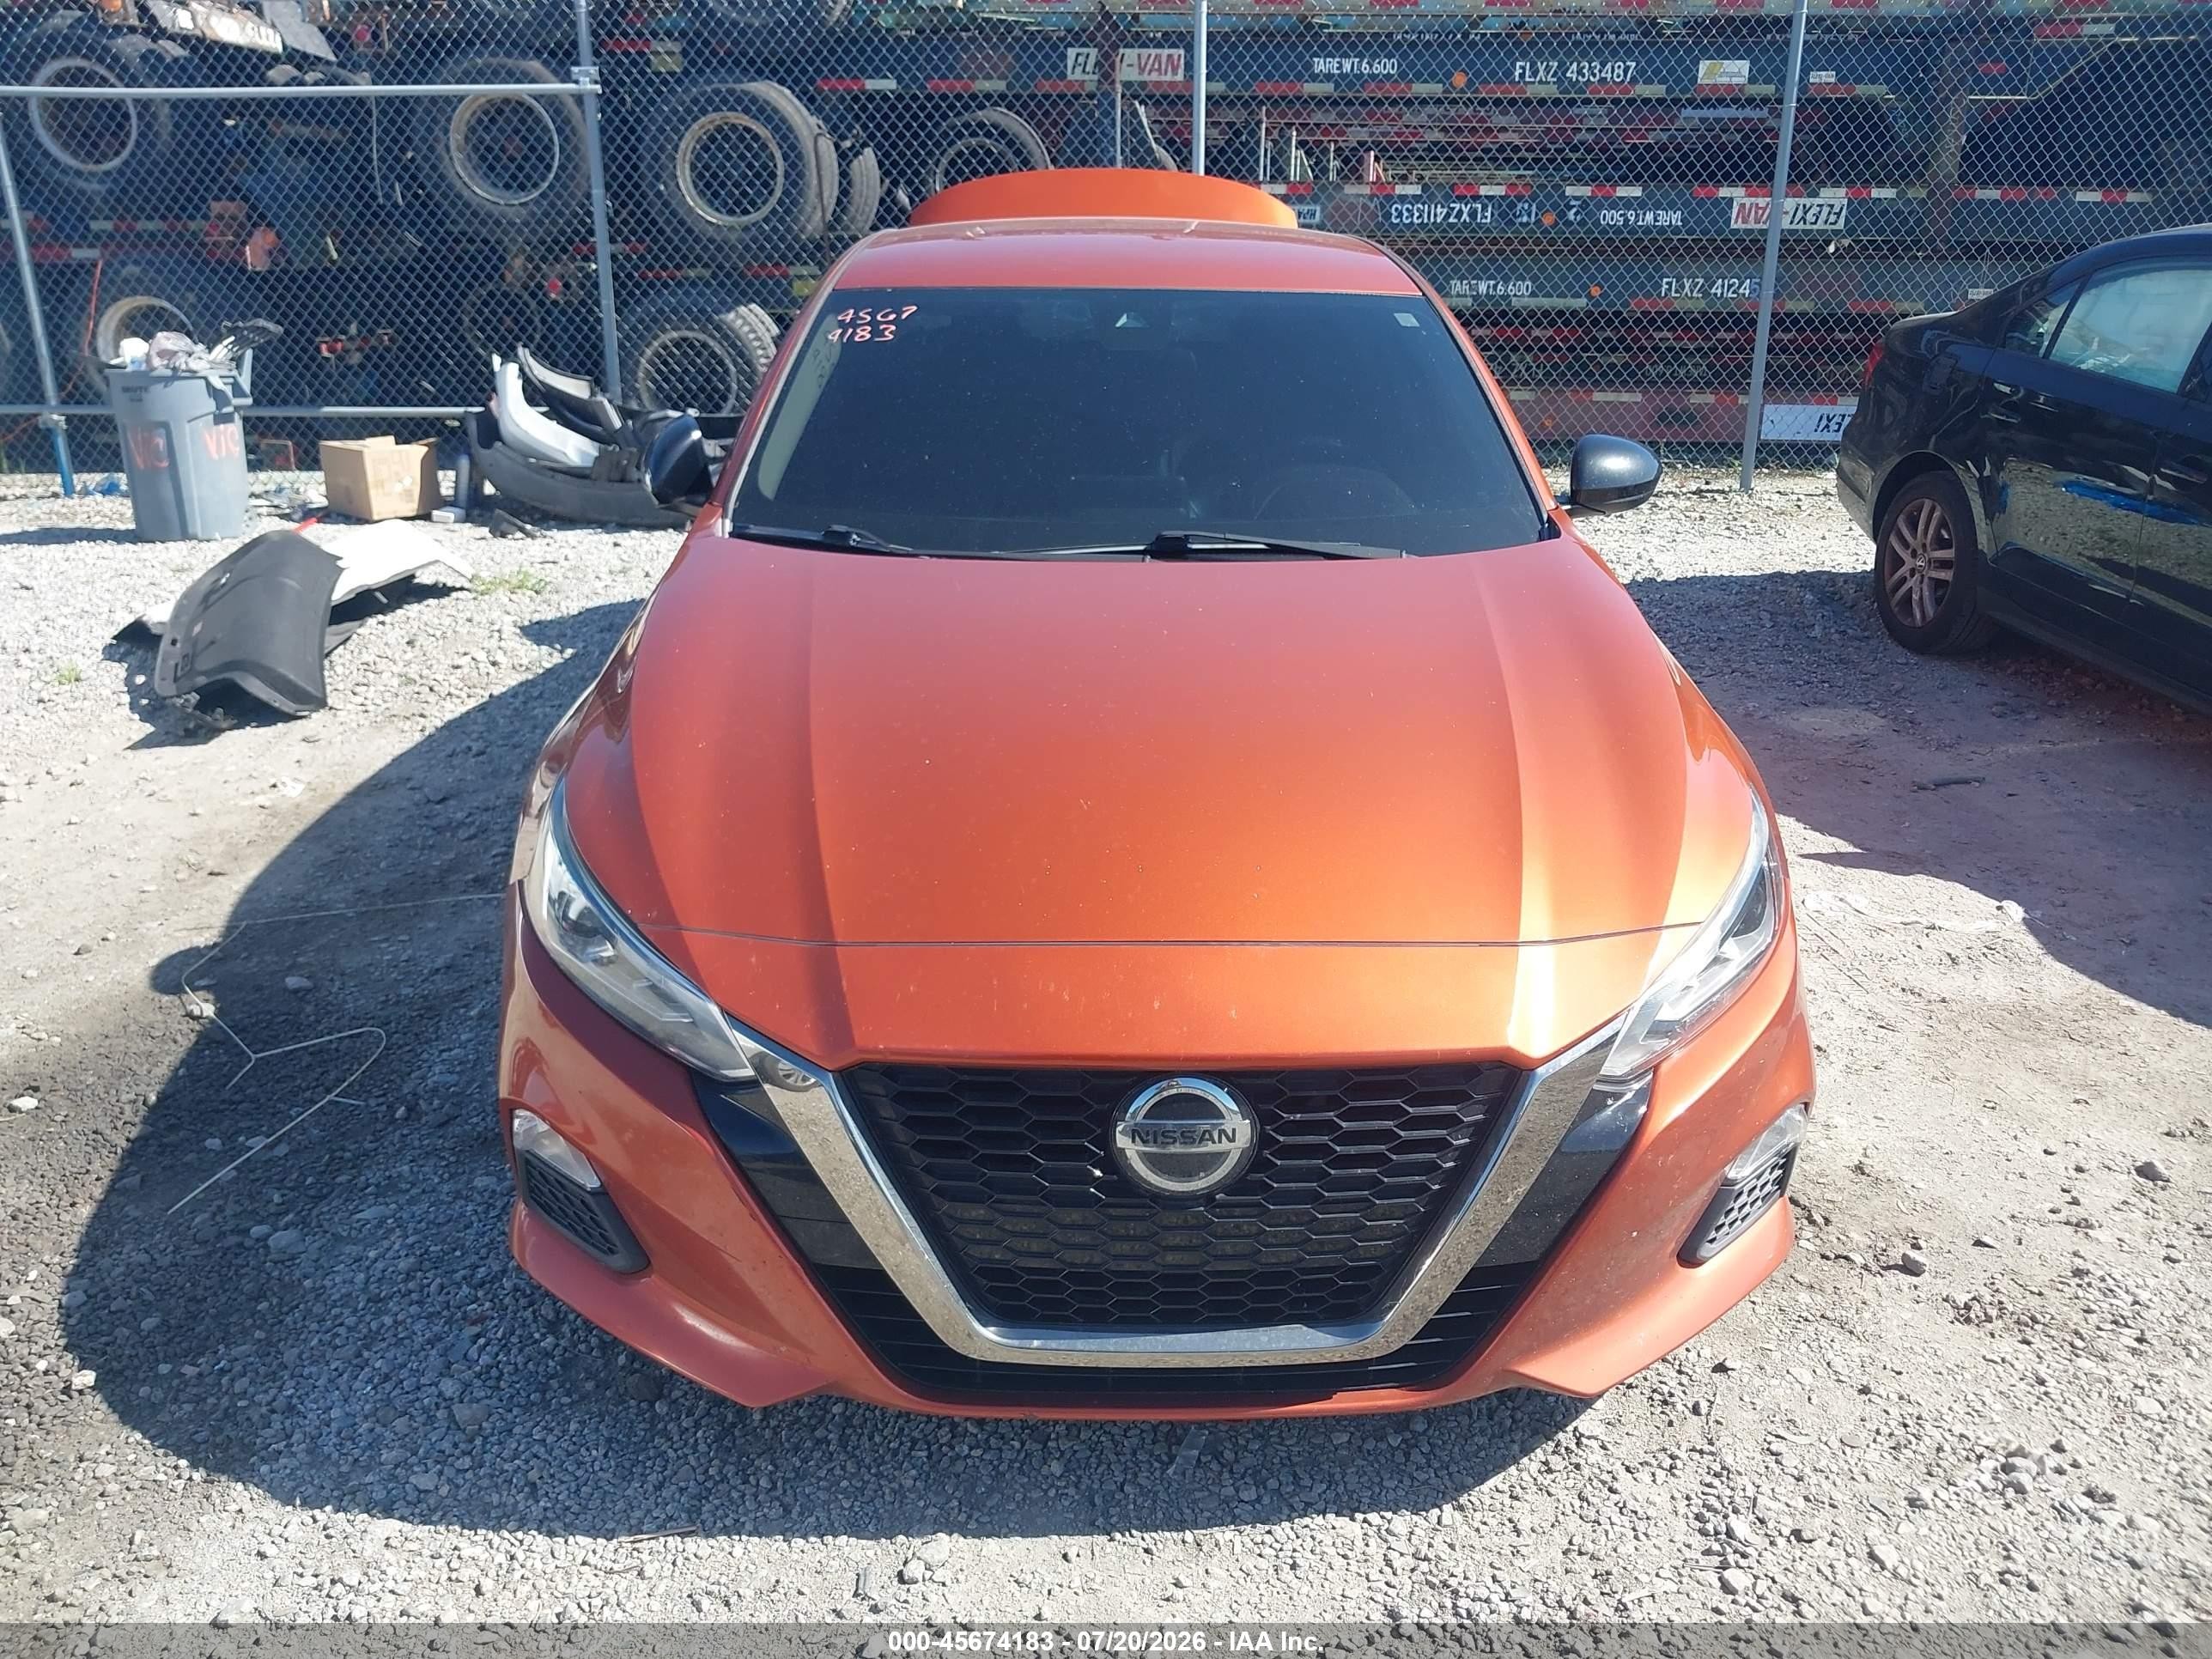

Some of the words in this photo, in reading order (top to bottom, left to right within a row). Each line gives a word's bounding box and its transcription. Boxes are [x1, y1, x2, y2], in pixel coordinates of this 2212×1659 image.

[1515, 61, 1558, 82] FLXZ
[1566, 61, 1636, 82] 433487
[1734, 203, 1845, 226] FLEXI-AN
[1661, 278, 1704, 297] FLXZ
[1710, 278, 1760, 298] 41245
[1131, 1127, 1237, 1145] NISSAN
